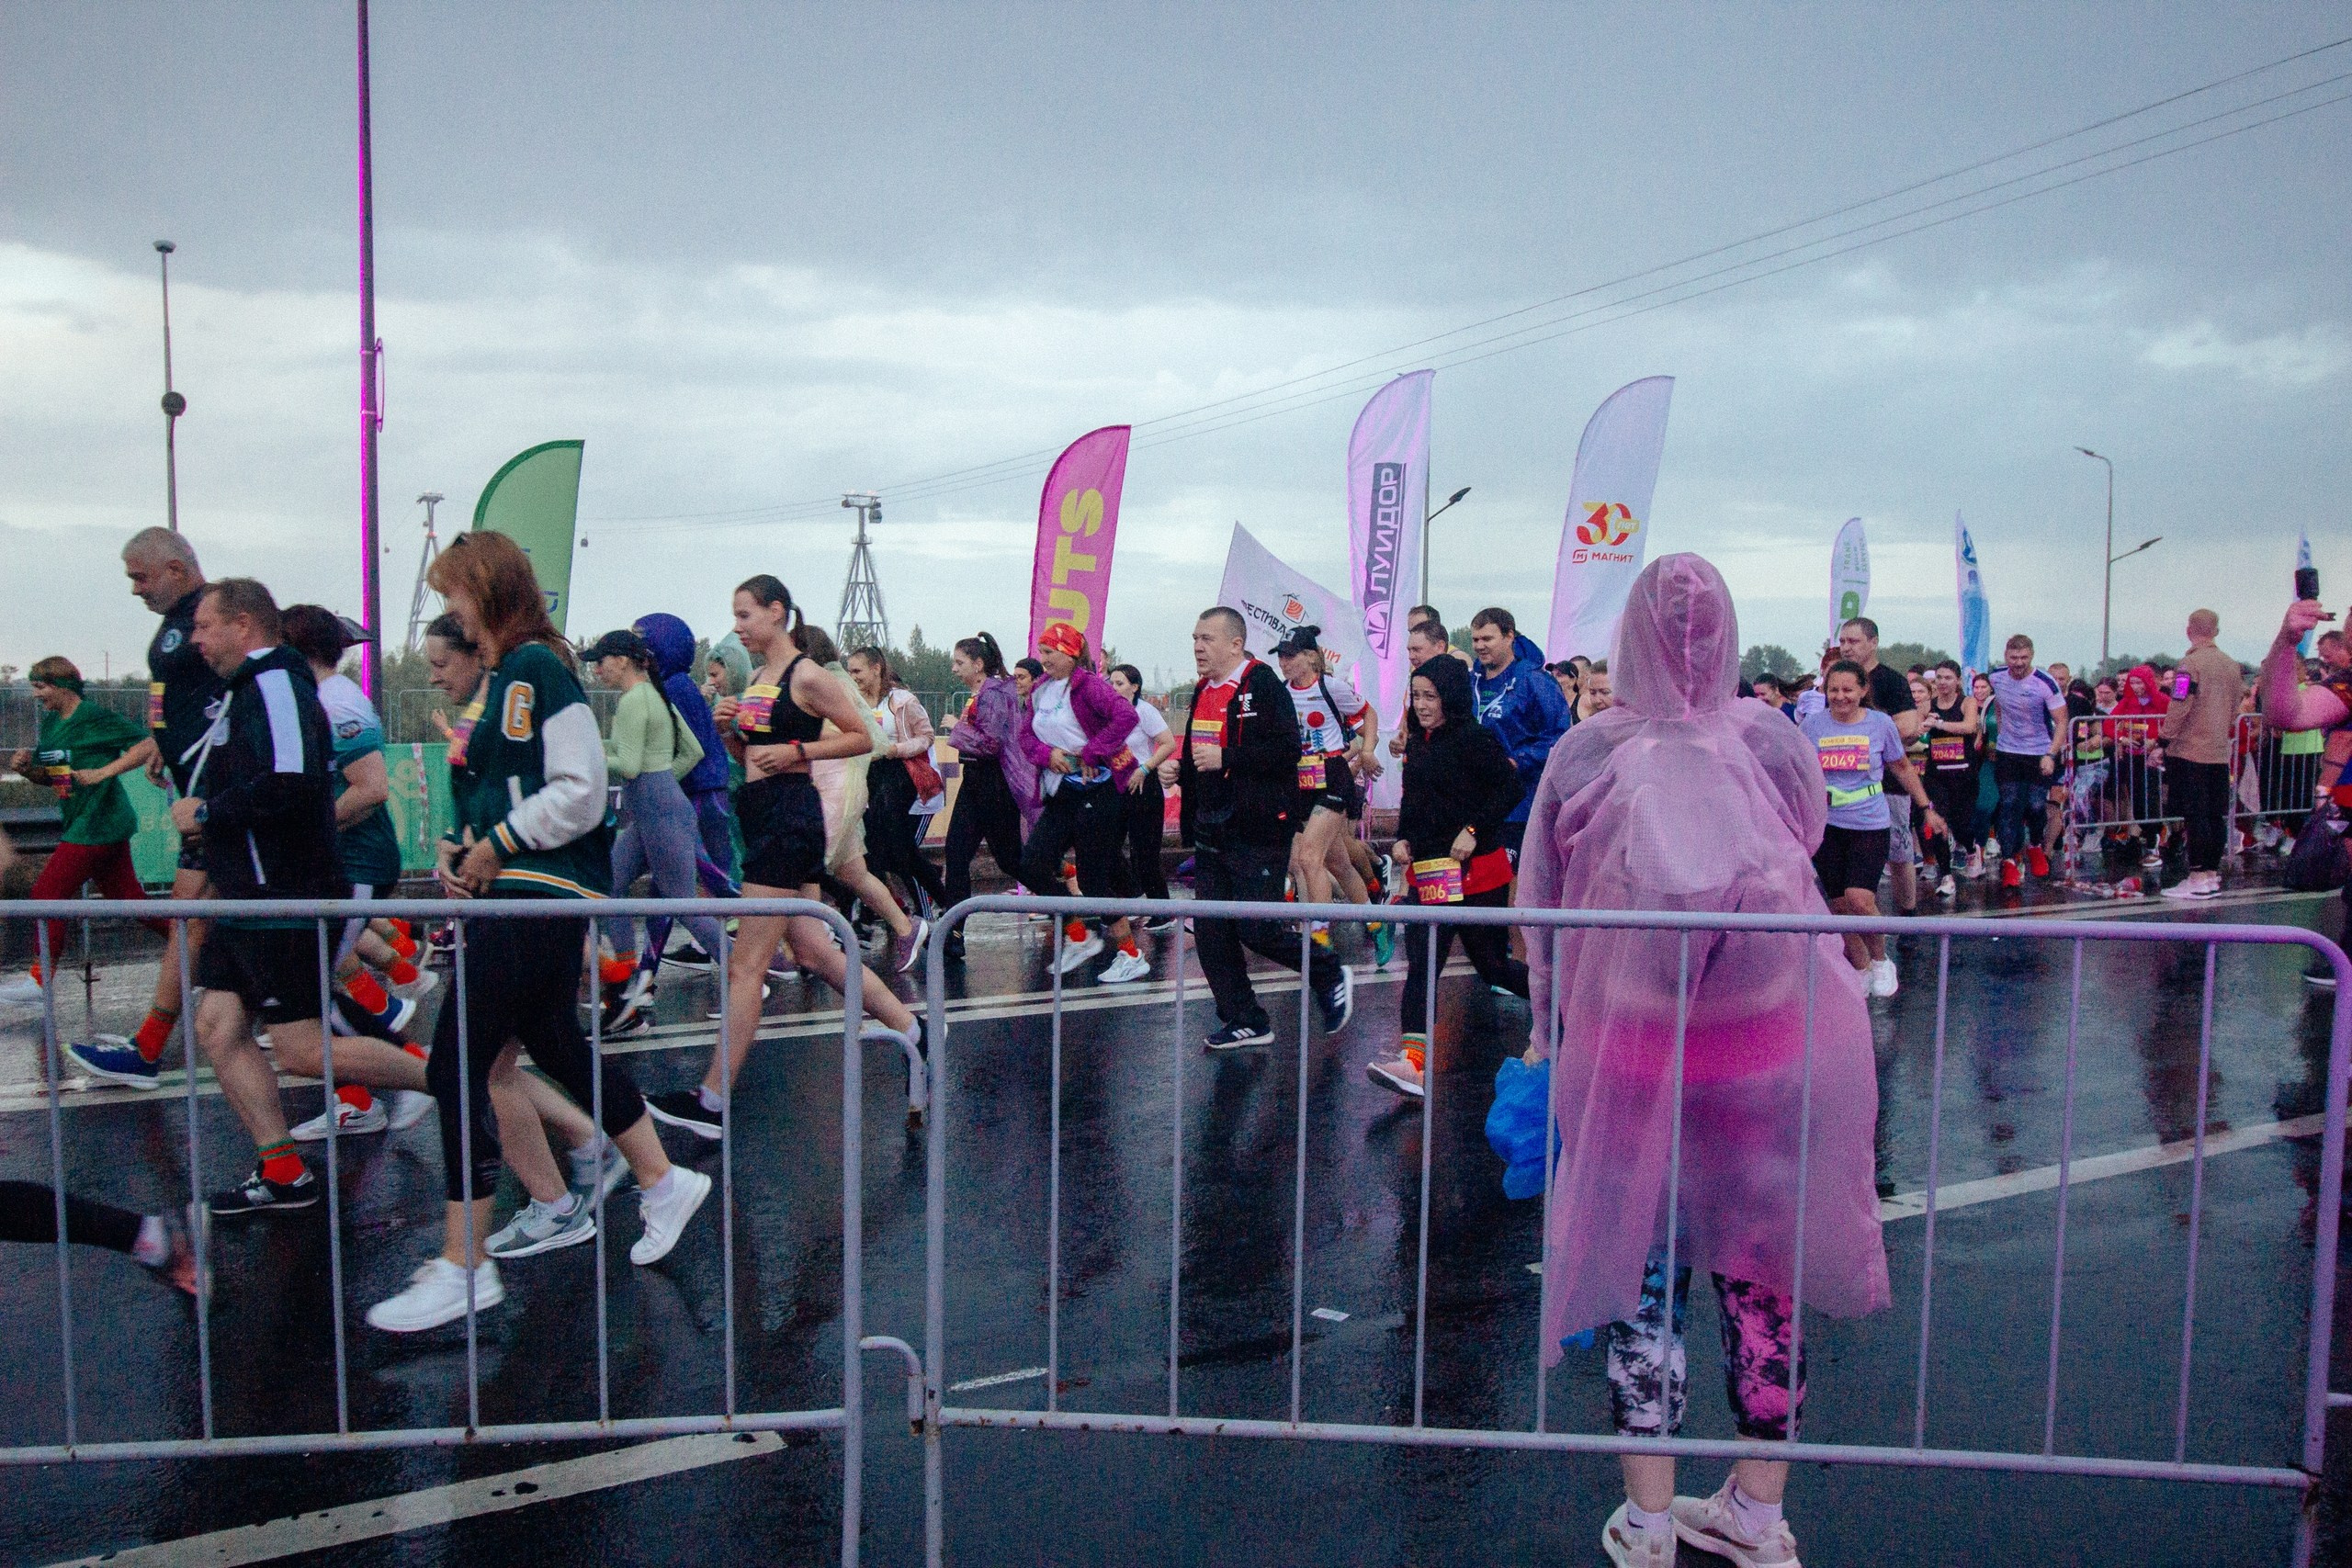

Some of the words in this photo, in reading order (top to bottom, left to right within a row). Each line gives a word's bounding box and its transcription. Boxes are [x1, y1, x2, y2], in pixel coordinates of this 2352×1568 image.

[1371, 468, 1399, 595] ЛУИДОР
[1577, 502, 1631, 546] 30
[1591, 552, 1634, 563] МАГНИТ
[503, 682, 534, 740] G
[1822, 754, 1856, 768] 2049
[1299, 774, 1315, 787] 30
